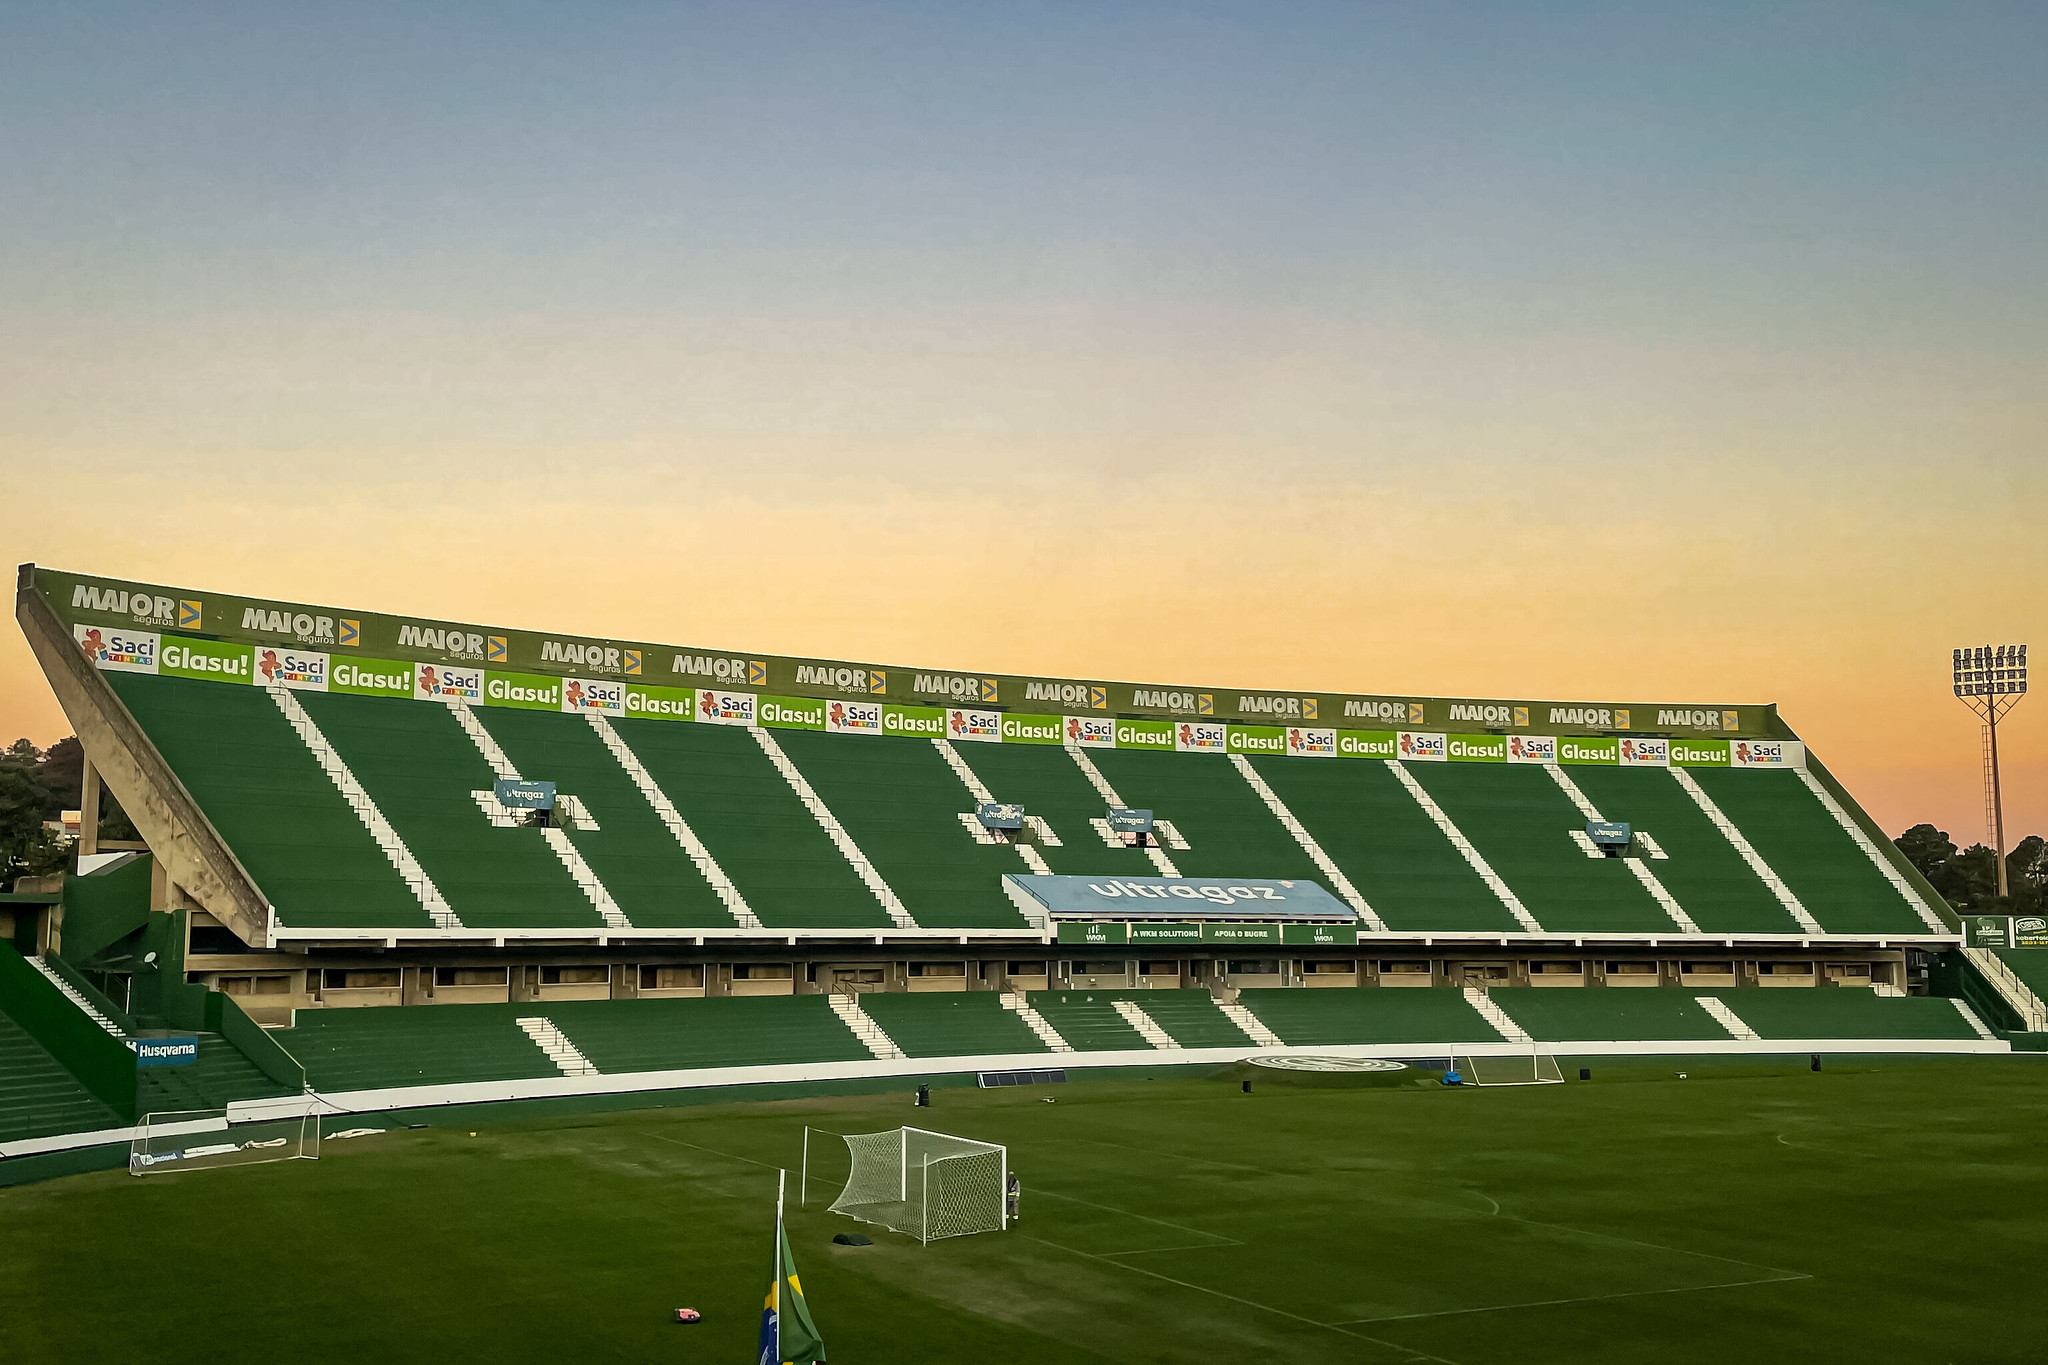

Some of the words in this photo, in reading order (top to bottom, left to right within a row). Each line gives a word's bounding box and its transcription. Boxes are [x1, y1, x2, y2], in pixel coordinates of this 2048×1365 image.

[72, 585, 175, 620] MAIOR
[133, 614, 174, 626] seguros
[241, 607, 334, 638] MAIOR
[111, 637, 154, 655] Saci
[297, 634, 334, 644] seguros
[398, 625, 484, 654] MAIOR
[110, 653, 152, 665] TINTAS
[162, 646, 248, 676] Glasu!
[450, 651, 484, 660] seguros
[541, 641, 620, 668] MAIOR
[284, 656, 324, 674] Saci
[588, 664, 621, 674] seguros
[672, 654, 746, 678] MAIOR
[284, 673, 322, 682] TINTAS
[333, 664, 410, 690] Glasu!
[443, 671, 478, 688] Saci
[716, 676, 746, 684] seguros
[795, 665, 866, 687] MAIOR
[442, 688, 478, 697] TINTAS
[488, 679, 558, 704] Glasu!
[587, 685, 620, 700] Saci
[838, 685, 867, 694] seguros
[913, 674, 978, 696] MAIOR
[1025, 682, 1088, 702] MAIOR
[586, 700, 620, 709] TINTAS
[626, 692, 690, 716] Glasu!
[721, 697, 752, 712] Saci
[951, 694, 979, 702] seguros
[1133, 690, 1196, 709] MAIOR
[1238, 696, 1300, 714] MAIOR
[720, 710, 752, 720] TINTAS
[760, 703, 822, 725] Glasu!
[849, 706, 878, 720] Saci
[1344, 701, 1406, 718] MAIOR
[1449, 704, 1510, 722] MAIOR
[1549, 707, 1612, 725] MAIOR
[1657, 709, 1719, 726] MAIOR
[848, 720, 878, 728] TINTAS
[884, 713, 944, 732] Glasu!
[969, 714, 998, 728] Saci
[1084, 722, 1112, 735] Saci
[1003, 720, 1060, 740] Glasu!
[1117, 726, 1172, 745] Glasu!
[1196, 727, 1223, 740] Saci
[1229, 732, 1284, 750] Glasu!
[1307, 733, 1333, 745] Saci
[1340, 737, 1394, 754] Glasu!
[1416, 737, 1443, 749] Saci
[1527, 740, 1553, 752] Saci
[1449, 741, 1504, 758] Glasu!
[1561, 744, 1616, 760] Glasu!
[1638, 742, 1666, 754] Saci
[1671, 746, 1726, 762] Glasu!
[1754, 744, 1781, 756] Saci
[506, 789, 544, 800] ultragaz
[1115, 816, 1144, 826] ultragaz
[1088, 879, 1286, 904] ultragaz
[1214, 930, 1236, 938] APOIA
[139, 1044, 195, 1058] Husqvarna
